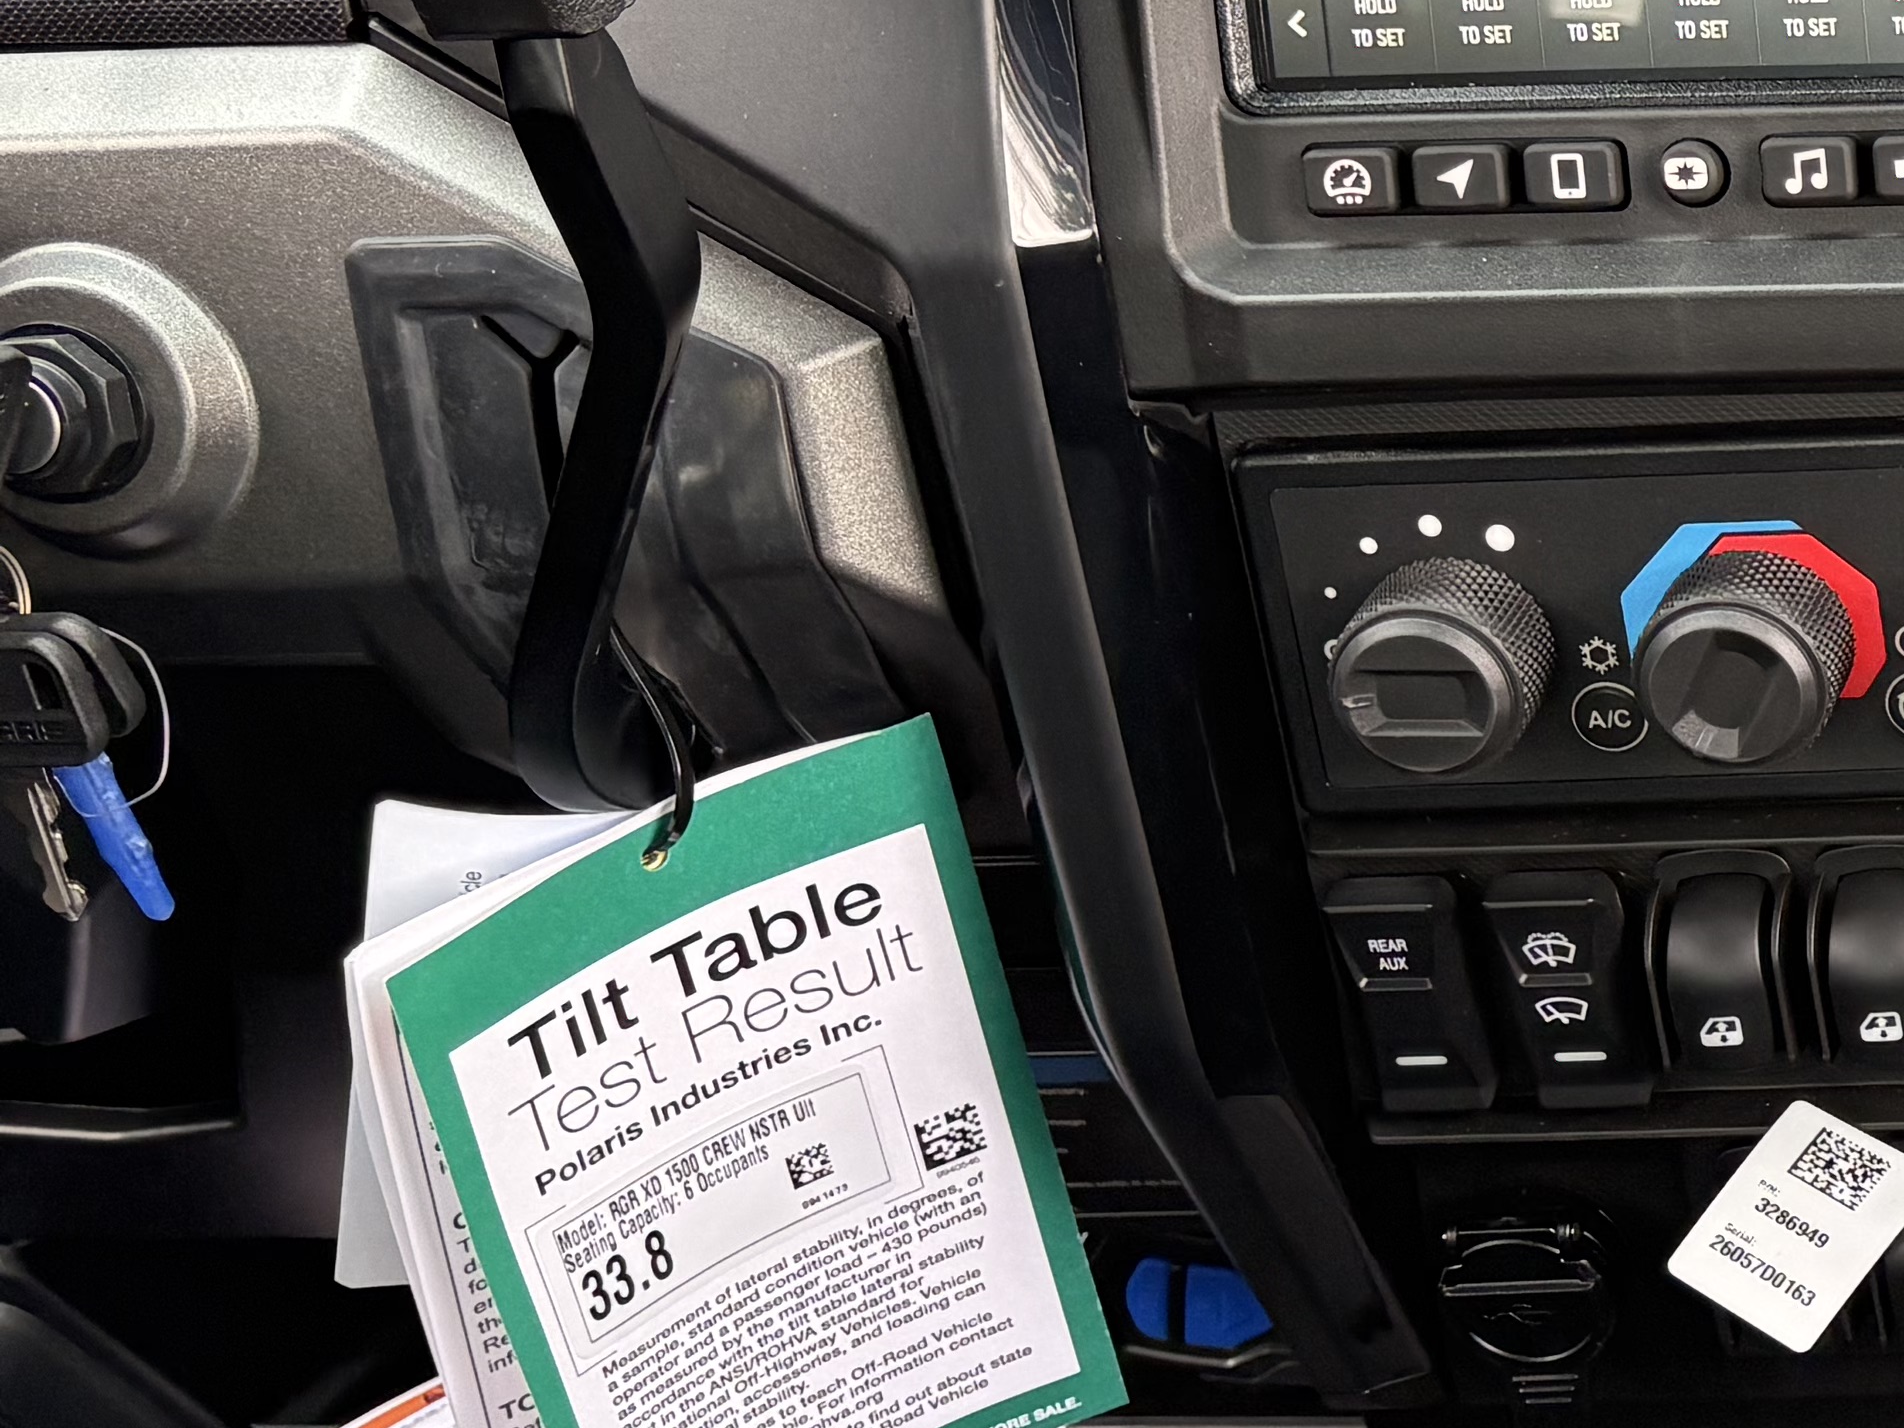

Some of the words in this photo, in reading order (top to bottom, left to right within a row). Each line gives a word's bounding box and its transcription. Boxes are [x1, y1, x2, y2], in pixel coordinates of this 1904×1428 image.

[1352, 29, 1373, 47] TO
[1376, 28, 1405, 46] SET
[1459, 26, 1480, 44] TO
[1484, 25, 1512, 44] SET
[1567, 23, 1588, 41] TO
[1592, 22, 1620, 41] SET
[1675, 20, 1696, 39] TO
[1700, 20, 1728, 38] SET
[1783, 18, 1804, 36] TO
[1808, 18, 1837, 36] SET
[1588, 709, 1632, 729] A/C
[1367, 938, 1408, 953] REAR
[1379, 957, 1409, 971] AUX
[507, 978, 640, 1080] Tilt
[649, 882, 882, 998] Table
[507, 1036, 668, 1152] Test
[680, 924, 924, 1064] Result
[534, 1121, 644, 1197] Polaris
[649, 1038, 812, 1127] Industries
[819, 1014, 882, 1046] Inc.
[557, 1212, 607, 1257] Model:
[608, 1189, 641, 1222] RGR
[639, 1175, 663, 1202] XD
[664, 1152, 700, 1187] 1500
[701, 1127, 746, 1167] CREW
[748, 1108, 791, 1143] NSTR
[564, 1231, 618, 1274] Seating
[617, 1191, 682, 1240] Capacity:
[683, 1180, 695, 1201] 6
[696, 1144, 770, 1193] Occupants
[1755, 1197, 1830, 1249] 3286949
[581, 1229, 674, 1321] 33.8
[601, 1300, 712, 1379] Measurement
[714, 1289, 732, 1305] of
[735, 1258, 789, 1294] lateral
[792, 1225, 864, 1266] stability,
[866, 1215, 884, 1230] in
[887, 1184, 963, 1220] degrees,
[966, 1170, 984, 1188] of
[607, 1380, 619, 1393] a
[621, 1339, 685, 1383] sample,
[687, 1289, 761, 1340] standard
[764, 1249, 845, 1295] condition
[847, 1220, 910, 1253] vehicle
[913, 1200, 956, 1227] (with
[959, 1190, 982, 1207] an
[1709, 1235, 1816, 1306] 26057D0163
[867, 1399, 901, 1425] find
[904, 1385, 933, 1407] out
[936, 1362, 987, 1392] about
[989, 1346, 1033, 1370] state
[927, 1378, 989, 1410] Vehicle
[1032, 1396, 1083, 1422] SALE.
